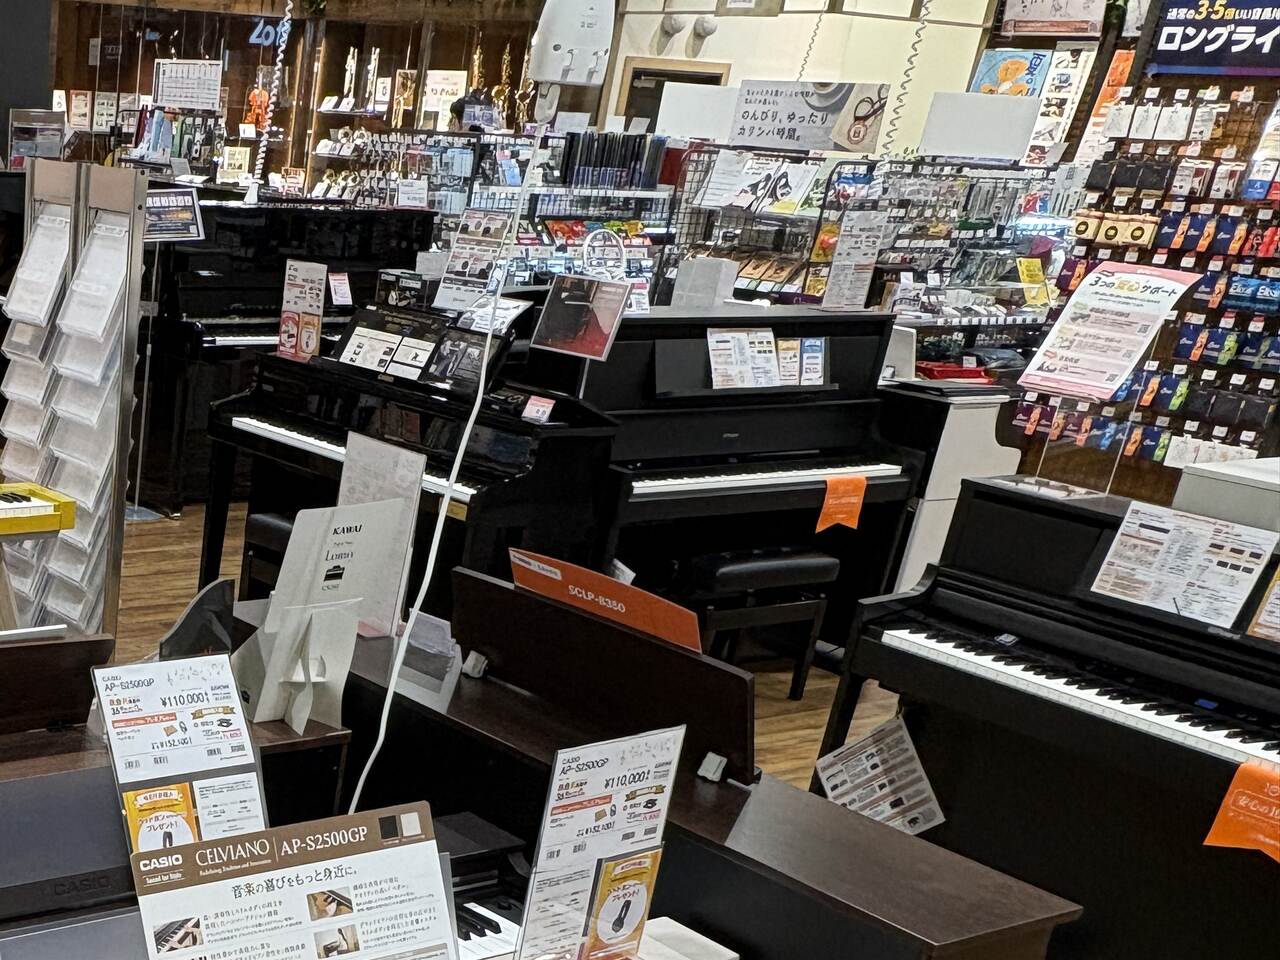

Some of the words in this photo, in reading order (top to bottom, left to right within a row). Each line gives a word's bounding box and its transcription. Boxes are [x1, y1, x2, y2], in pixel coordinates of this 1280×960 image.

[741, 109, 829, 125] のんびり、ゆったり
[160, 692, 205, 708] ¥110,000
[604, 771, 646, 789] ¥110,000
[195, 839, 270, 867] CELVIANO
[280, 827, 368, 856] AP-S2500GP
[139, 854, 183, 871] CASIO
[231, 865, 358, 899] 音楽の喜びをもっと身近に。
